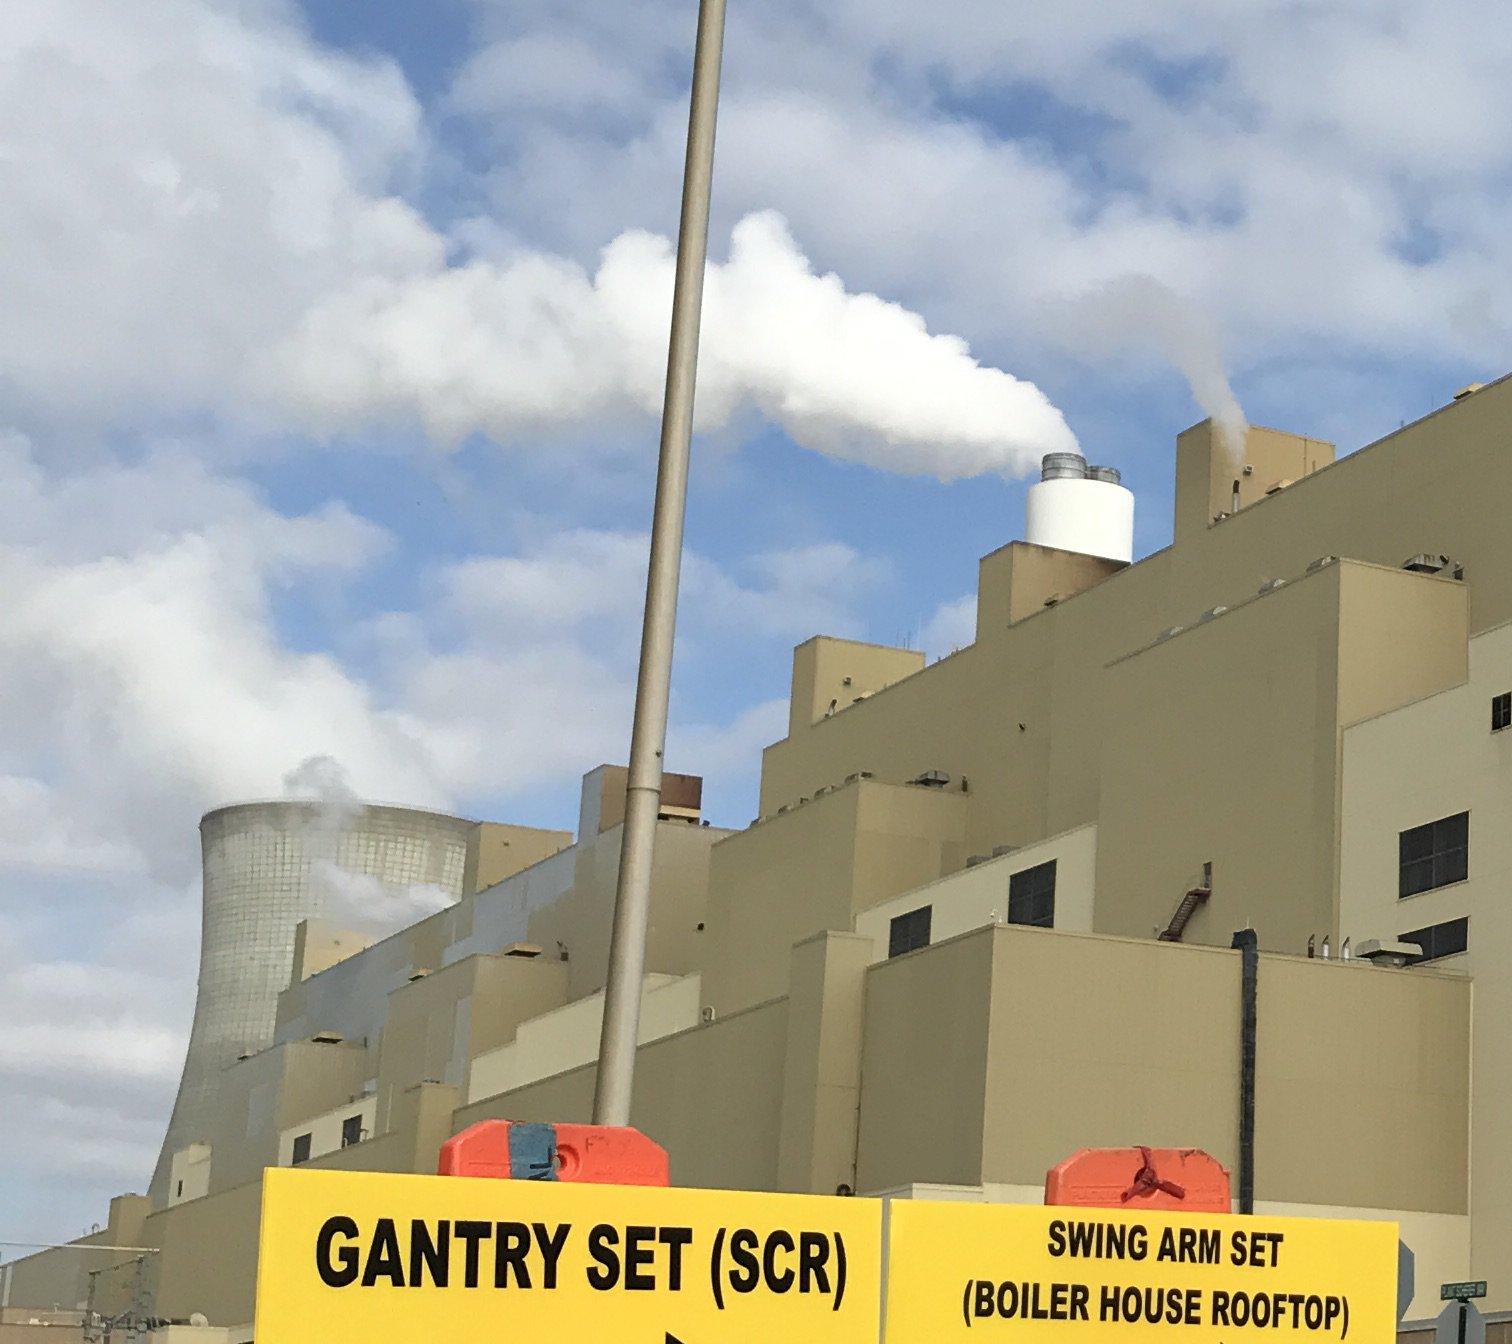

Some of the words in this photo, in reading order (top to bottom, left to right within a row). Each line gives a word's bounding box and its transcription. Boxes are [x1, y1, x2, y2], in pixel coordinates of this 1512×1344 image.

[316, 1215, 572, 1290] GANTRY
[586, 1223, 693, 1291] SET
[710, 1227, 847, 1312] (SCR)
[1047, 1220, 1148, 1261] SWING
[1156, 1227, 1221, 1265] ARM
[1230, 1230, 1284, 1268] SET
[963, 1279, 1090, 1327] (BOILER
[1099, 1285, 1202, 1325] HOUSE
[1211, 1290, 1349, 1340] ROOFTOP)
